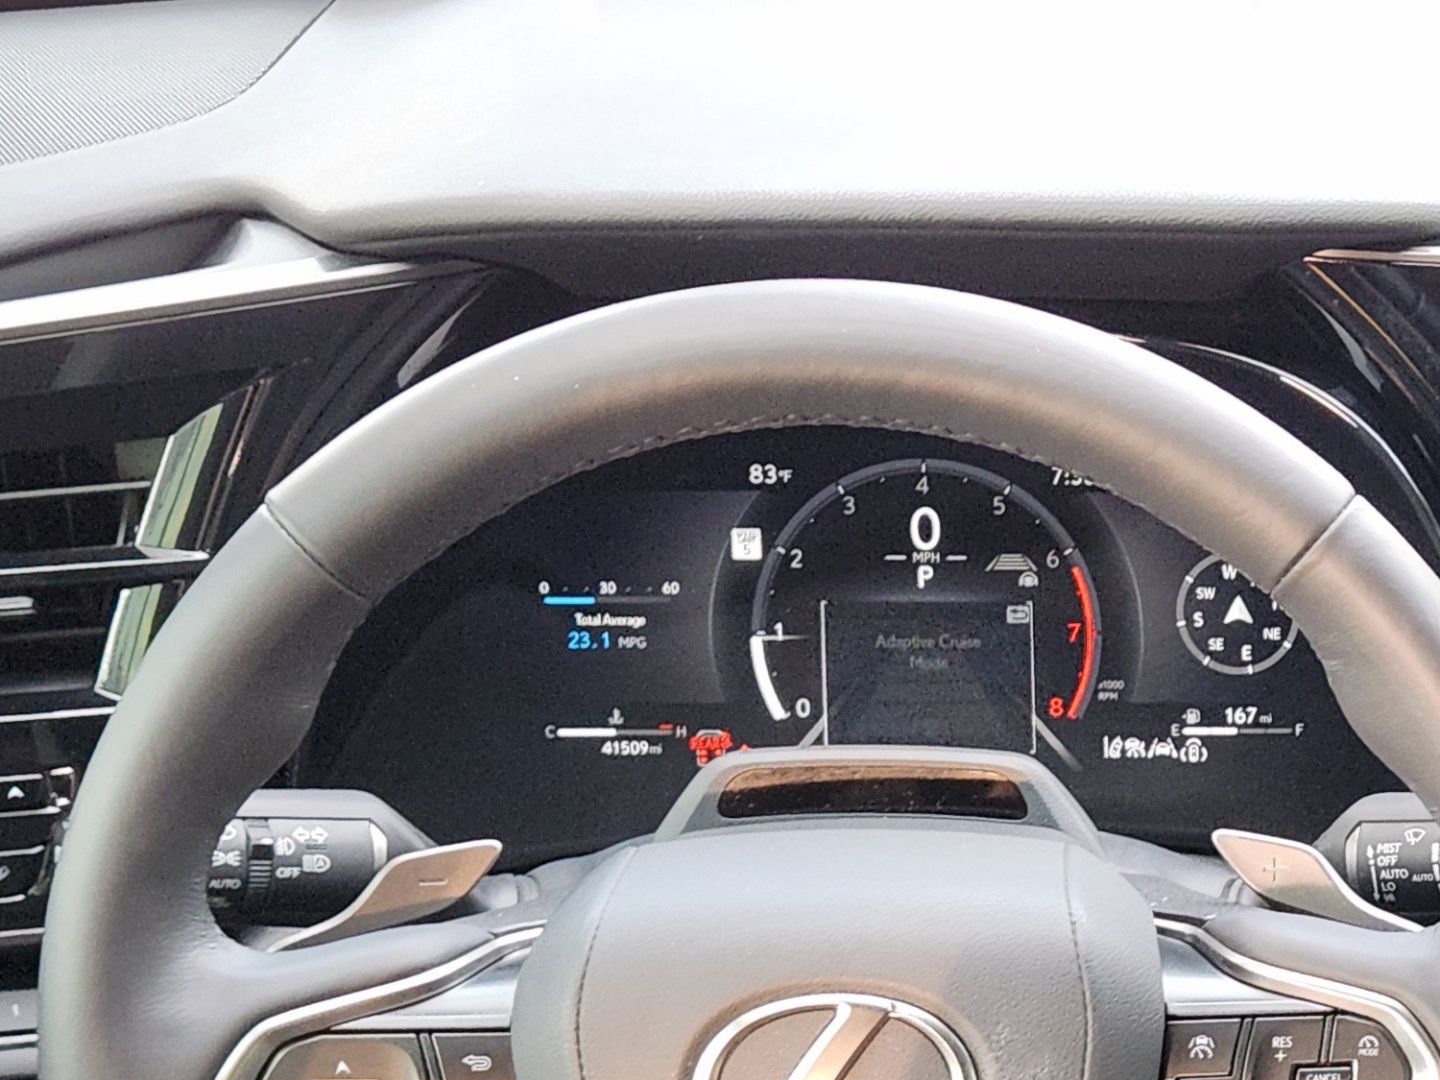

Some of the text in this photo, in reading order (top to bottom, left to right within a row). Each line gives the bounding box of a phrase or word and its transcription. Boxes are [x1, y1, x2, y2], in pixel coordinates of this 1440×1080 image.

[915, 478, 928, 495] 4
[843, 496, 855, 515] 3
[993, 498, 1005, 515] 5
[910, 506, 941, 551] 0
[790, 550, 803, 568] 2
[912, 552, 940, 564] MPH
[1046, 552, 1059, 569] 6
[917, 566, 934, 588] P
[1220, 564, 1237, 580] W
[538, 581, 550, 595] 0
[599, 581, 617, 595] 30
[662, 581, 680, 595] 60
[1196, 587, 1216, 601] SW
[575, 613, 646, 629] Total Average
[1193, 612, 1204, 626] S
[568, 631, 647, 649] 23.1 MPG
[1068, 624, 1081, 642] 7
[1264, 627, 1281, 641] NE
[1208, 638, 1225, 651] SE
[1241, 645, 1252, 660] E
[795, 699, 810, 718] 0
[1049, 699, 1064, 717] 8
[1225, 707, 1257, 724] 167
[544, 726, 556, 739] C
[676, 726, 687, 738] H
[1171, 724, 1180, 737] E
[1296, 724, 1304, 737] F
[1376, 842, 1402, 854] MIST
[1376, 855, 1399, 867] OFF
[275, 867, 301, 879] OFF
[1380, 868, 1409, 880] AUTO
[1411, 873, 1434, 882] AUTO
[208, 879, 242, 890] AUTO
[1381, 881, 1397, 892] LO
[1272, 1036, 1293, 1048] RES
